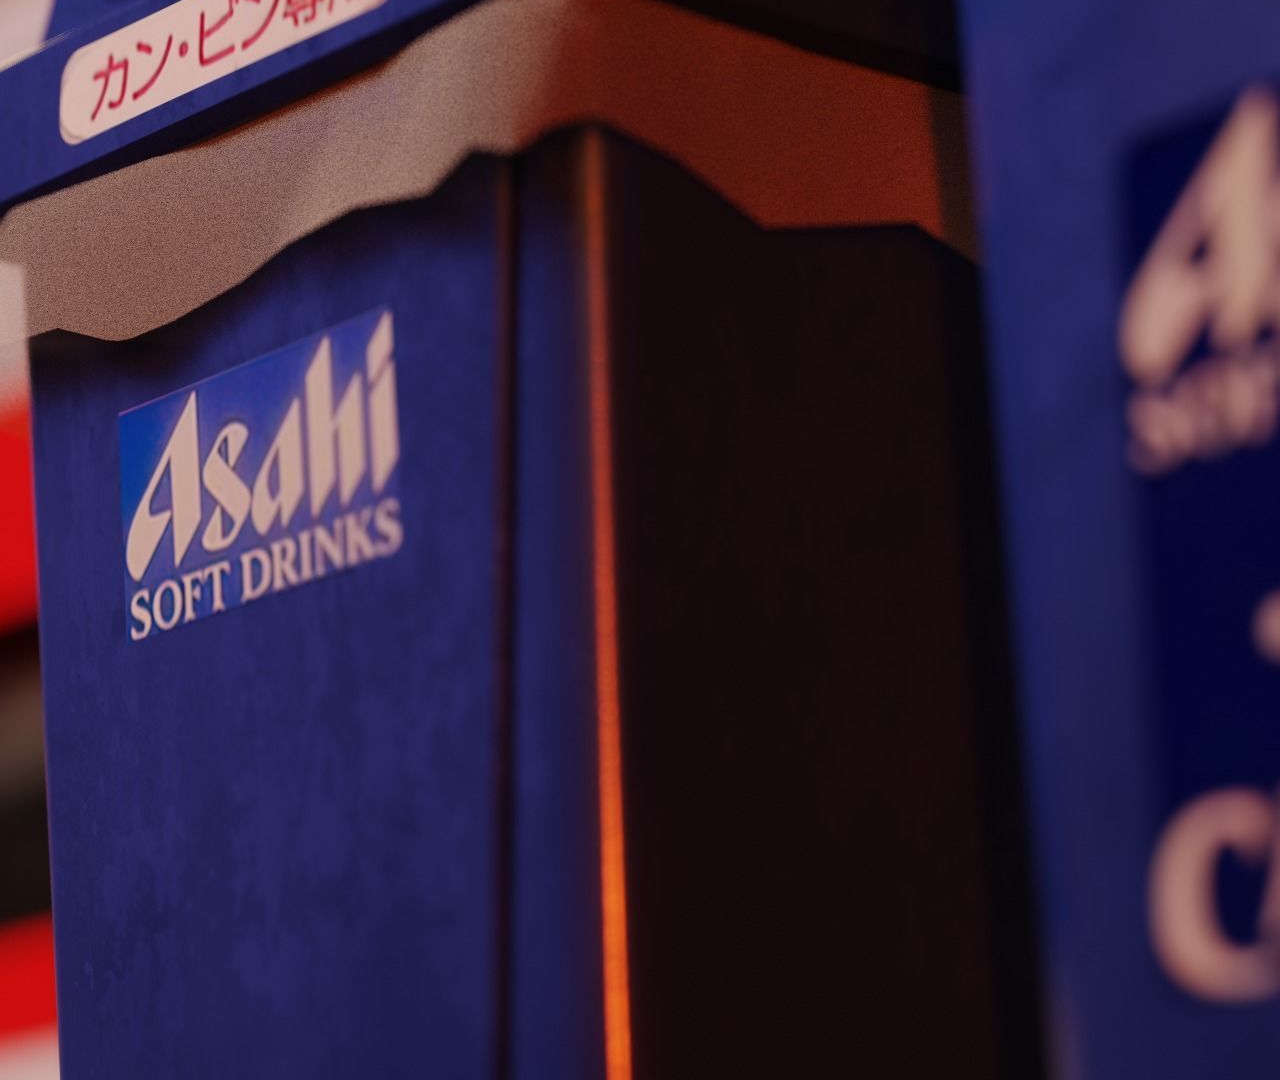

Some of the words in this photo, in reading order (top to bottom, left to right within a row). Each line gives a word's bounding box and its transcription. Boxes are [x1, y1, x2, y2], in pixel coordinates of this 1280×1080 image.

[126, 310, 401, 582] Asahi
[130, 560, 231, 641] SOFT
[240, 497, 404, 602] DRINKS
